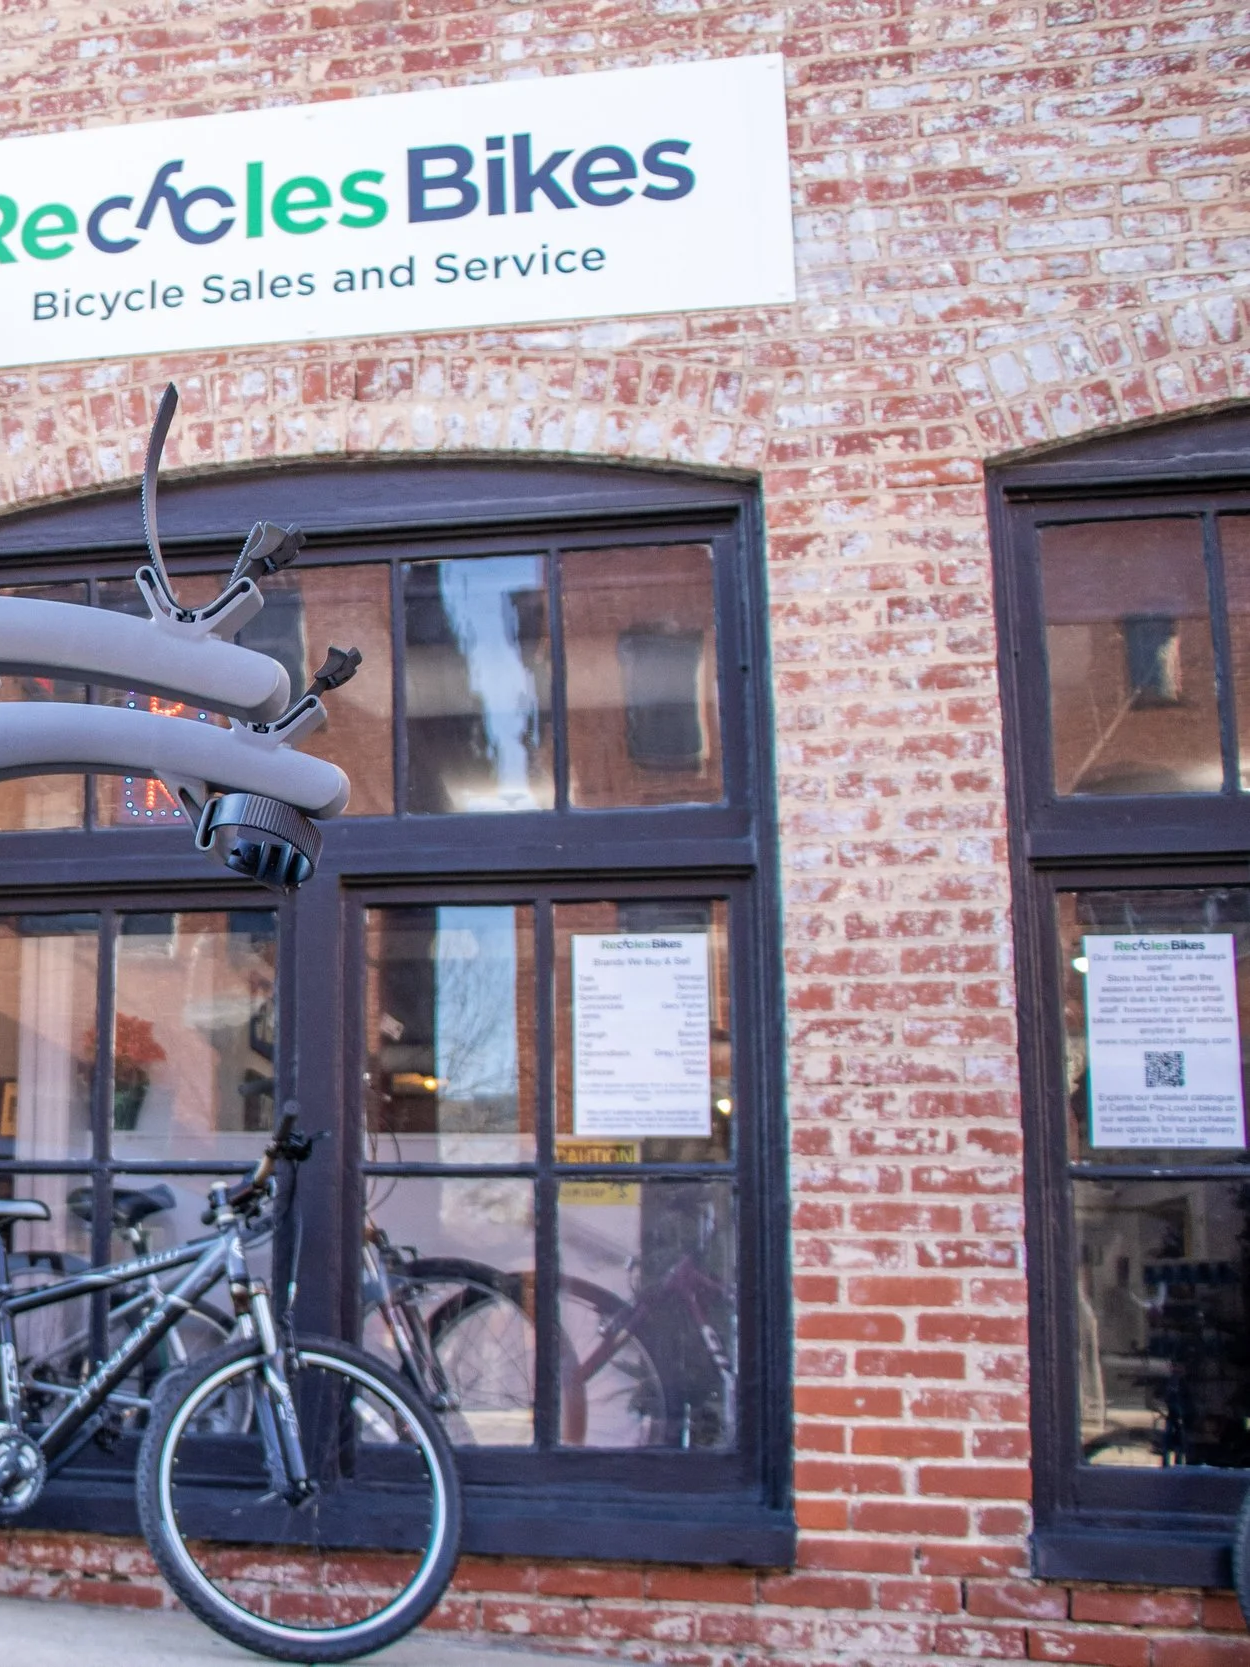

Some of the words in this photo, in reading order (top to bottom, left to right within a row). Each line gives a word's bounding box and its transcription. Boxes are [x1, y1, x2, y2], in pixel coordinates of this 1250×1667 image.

[406, 132, 696, 224] Bikes
[33, 280, 184, 321] Bicycle
[202, 269, 316, 305] Sales
[333, 255, 415, 293] and
[435, 247, 607, 284] Service
